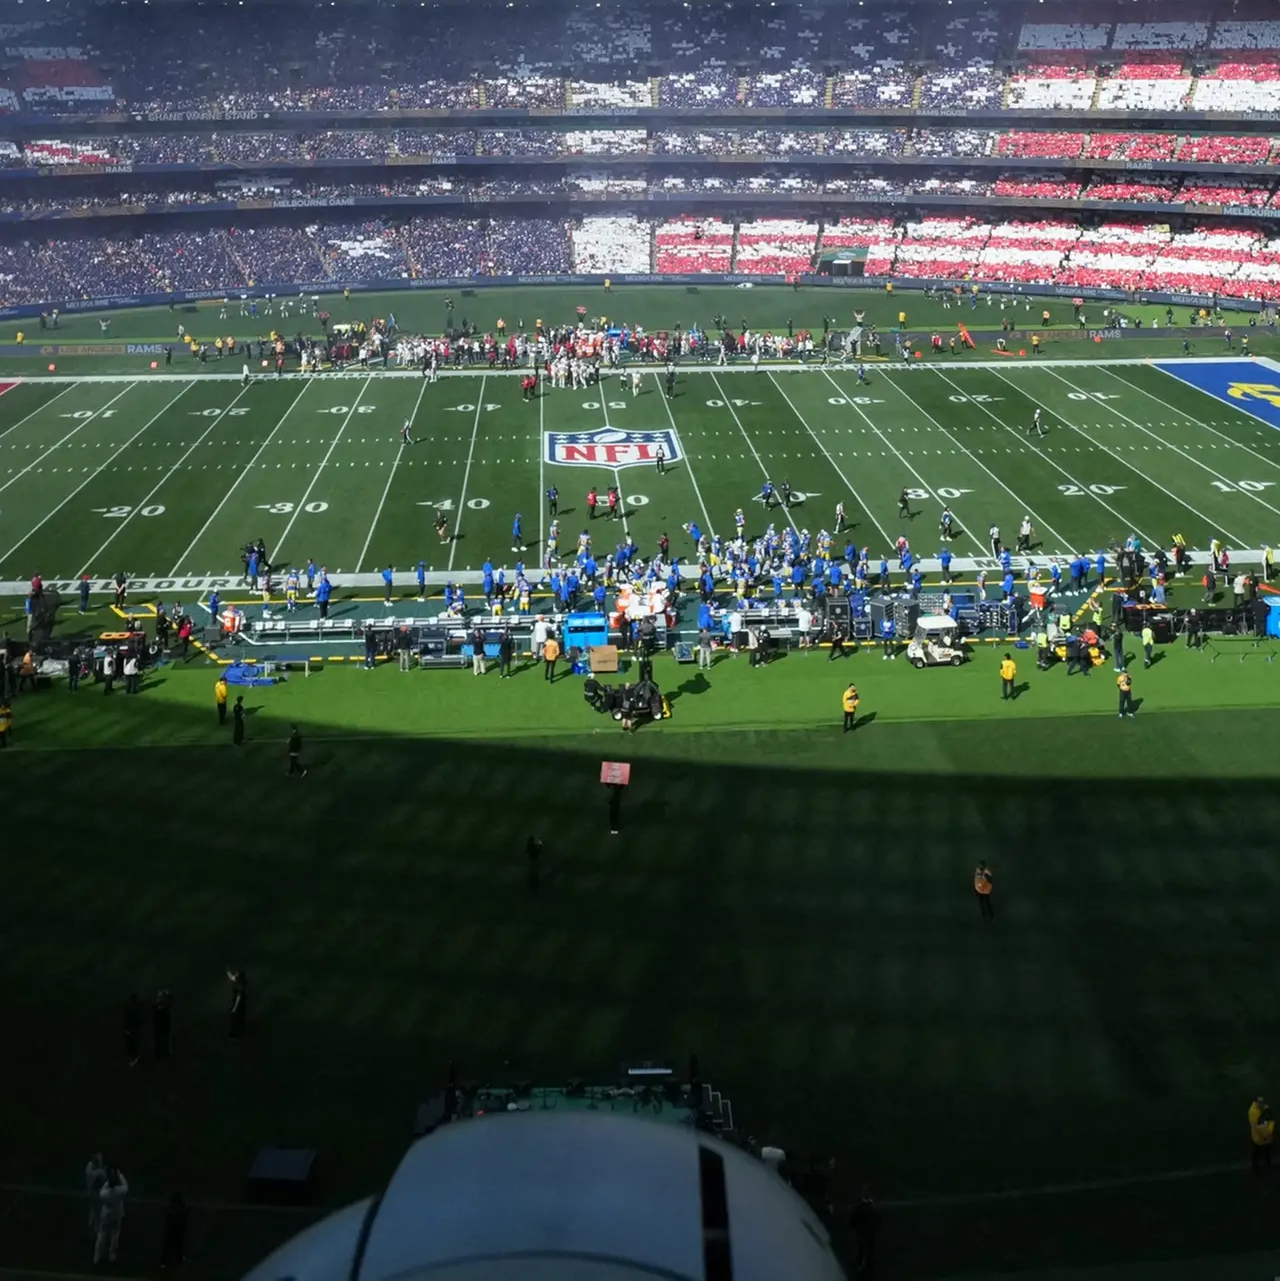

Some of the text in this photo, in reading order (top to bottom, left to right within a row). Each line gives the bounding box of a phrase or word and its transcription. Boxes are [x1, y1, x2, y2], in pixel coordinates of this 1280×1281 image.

[148, 112, 183, 121] SHANE
[225, 110, 258, 120] STAND
[1126, 162, 1154, 170] RAMS
[1089, 329, 1122, 339] RAMS
[127, 344, 161, 354] RAMS
[562, 444, 665, 462] NFL
[1058, 483, 1116, 497] 20
[1218, 479, 1266, 492] 10
[905, 487, 963, 500] 30
[103, 504, 167, 518] 20
[265, 500, 330, 514] 30
[427, 498, 491, 511] 40
